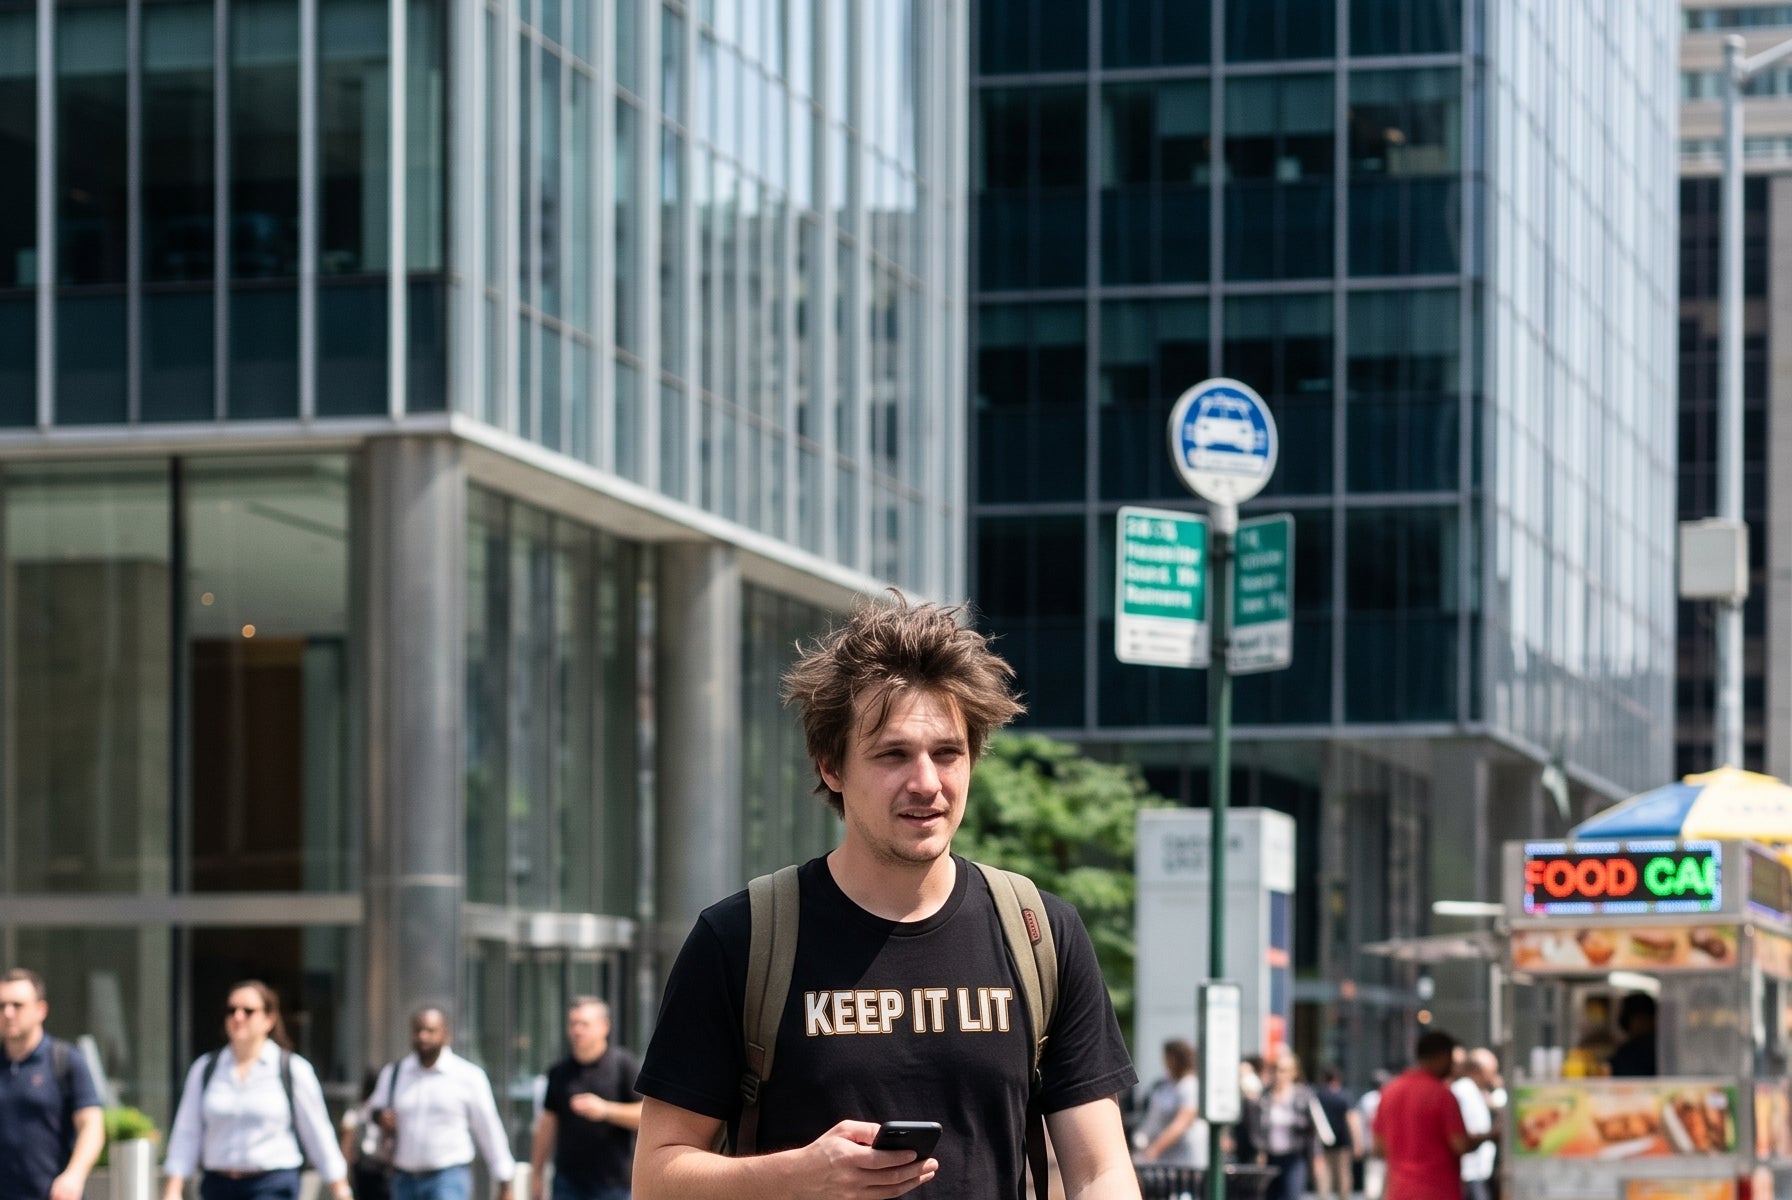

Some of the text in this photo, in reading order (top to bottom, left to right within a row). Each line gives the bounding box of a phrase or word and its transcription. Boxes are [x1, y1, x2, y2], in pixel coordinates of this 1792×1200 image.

[1525, 859, 1637, 898] FOOD
[804, 987, 1013, 1037] KEEP IT LIT
